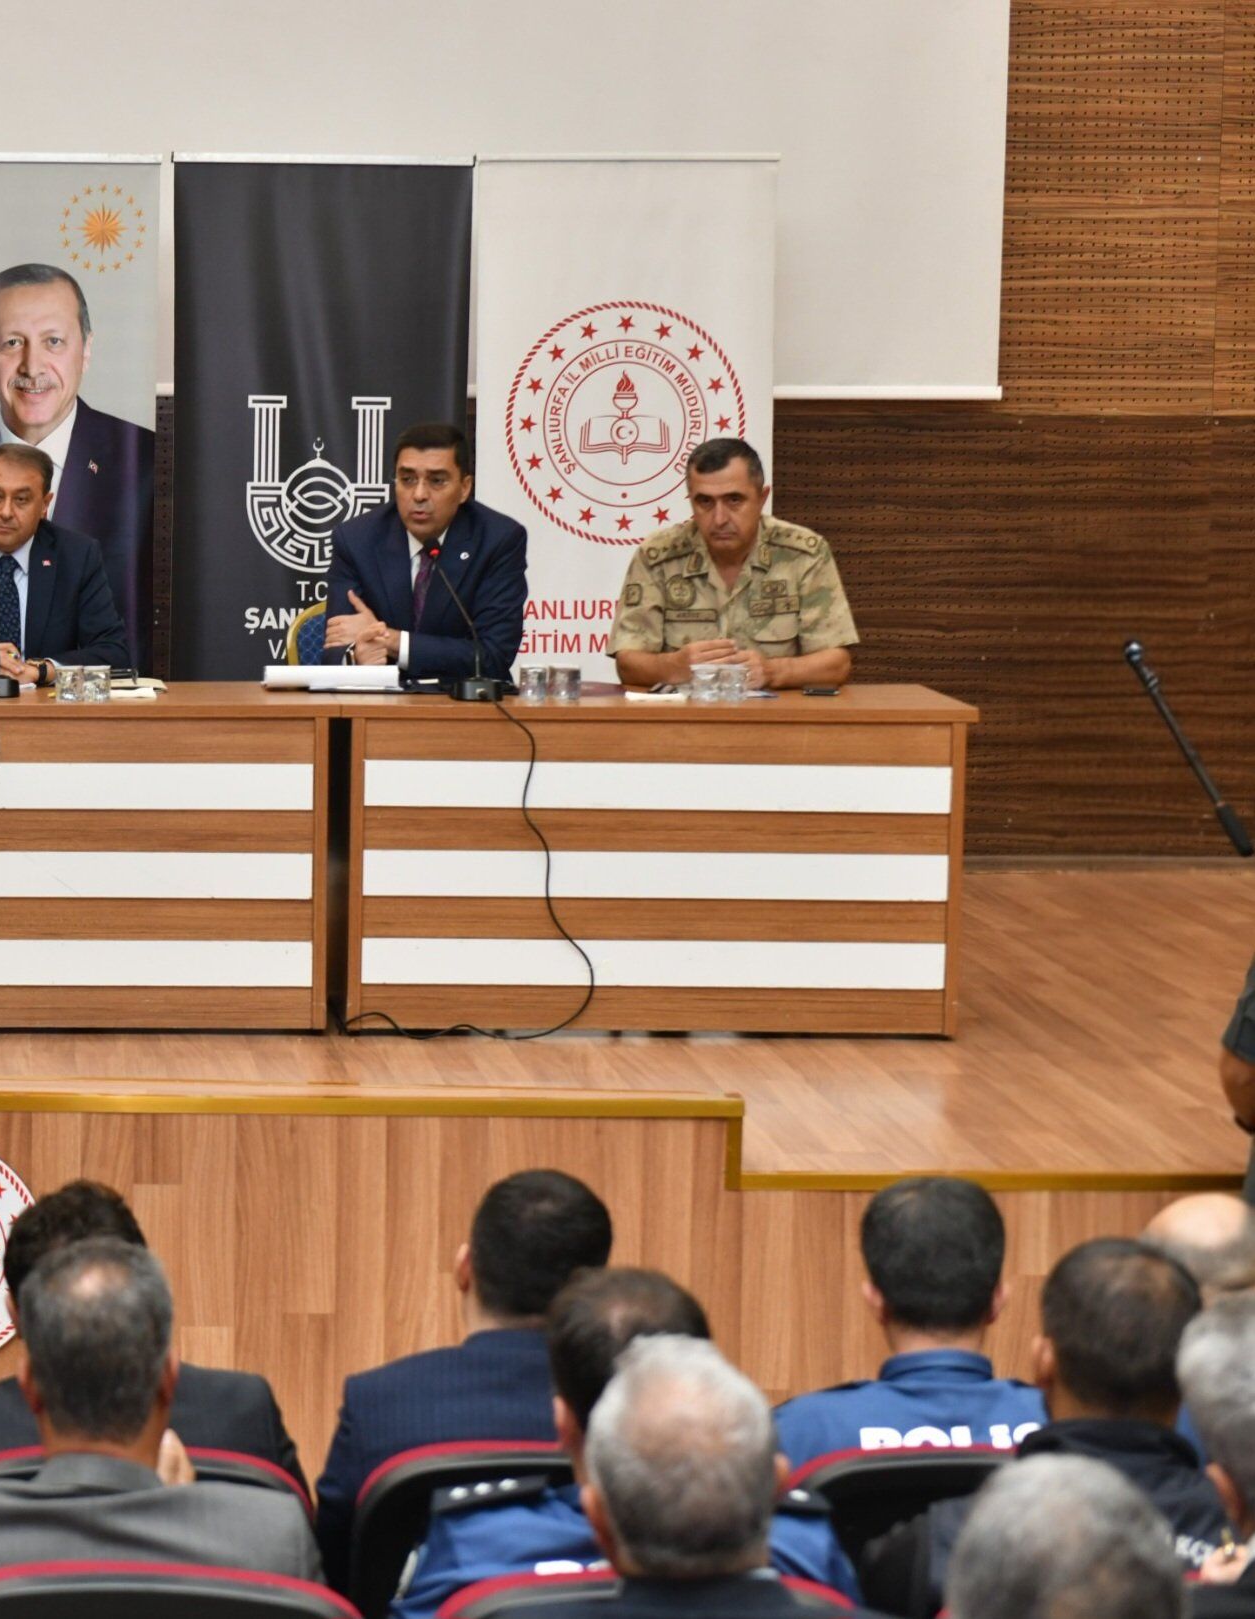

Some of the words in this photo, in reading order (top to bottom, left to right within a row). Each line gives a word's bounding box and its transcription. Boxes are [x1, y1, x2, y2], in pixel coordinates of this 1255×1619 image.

[549, 387, 577, 475] ŞANLIURFA
[563, 371, 580, 384] İL
[579, 344, 619, 372] MİLLİ
[624, 345, 676, 375] EĞİTİM
[244, 607, 303, 634] ŞAN
[523, 600, 618, 620] ANLIUR
[517, 629, 581, 653] ĞİTİM
